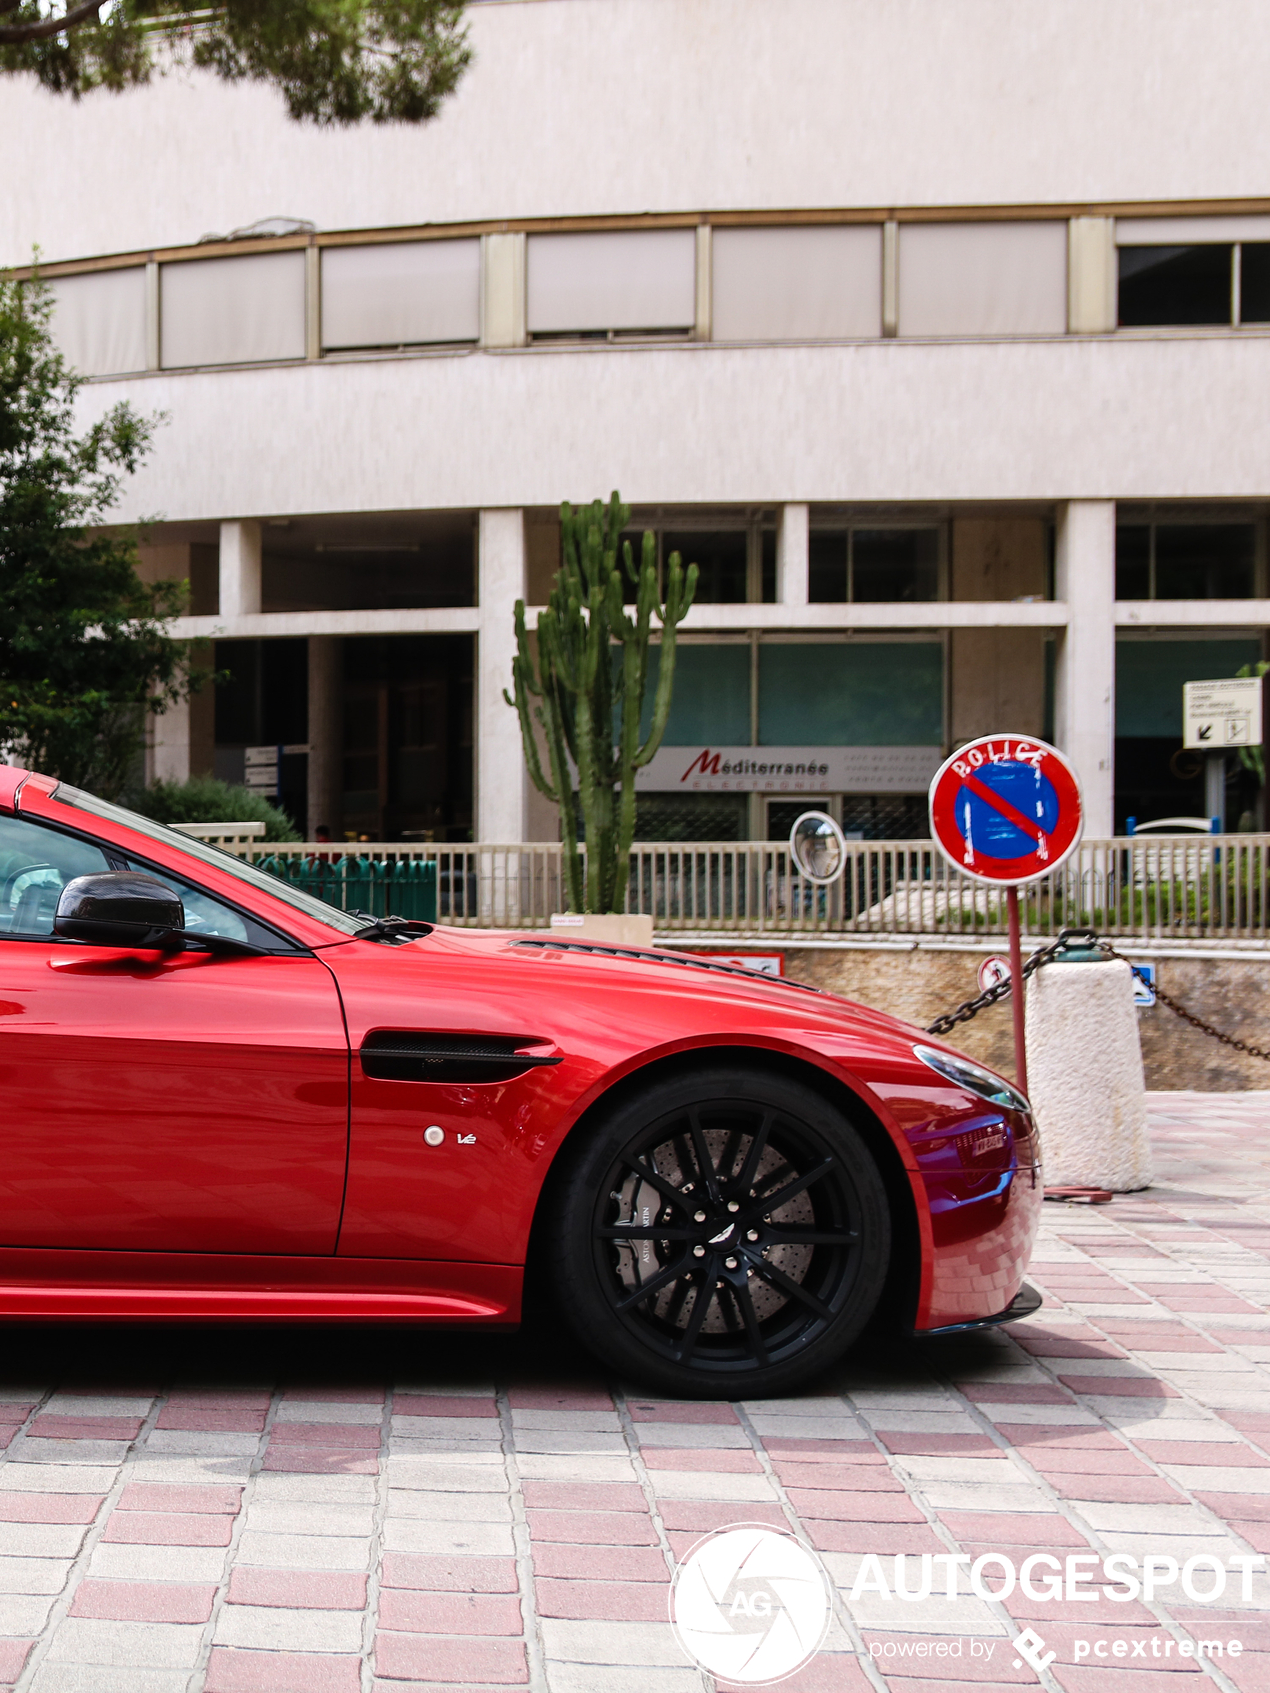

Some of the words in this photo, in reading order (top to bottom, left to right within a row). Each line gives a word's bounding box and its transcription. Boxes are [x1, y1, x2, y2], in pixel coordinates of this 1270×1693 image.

[680, 747, 830, 783] Méditerranée
[950, 740, 1048, 778] POLICE
[642, 1206, 650, 1227] ARTIN
